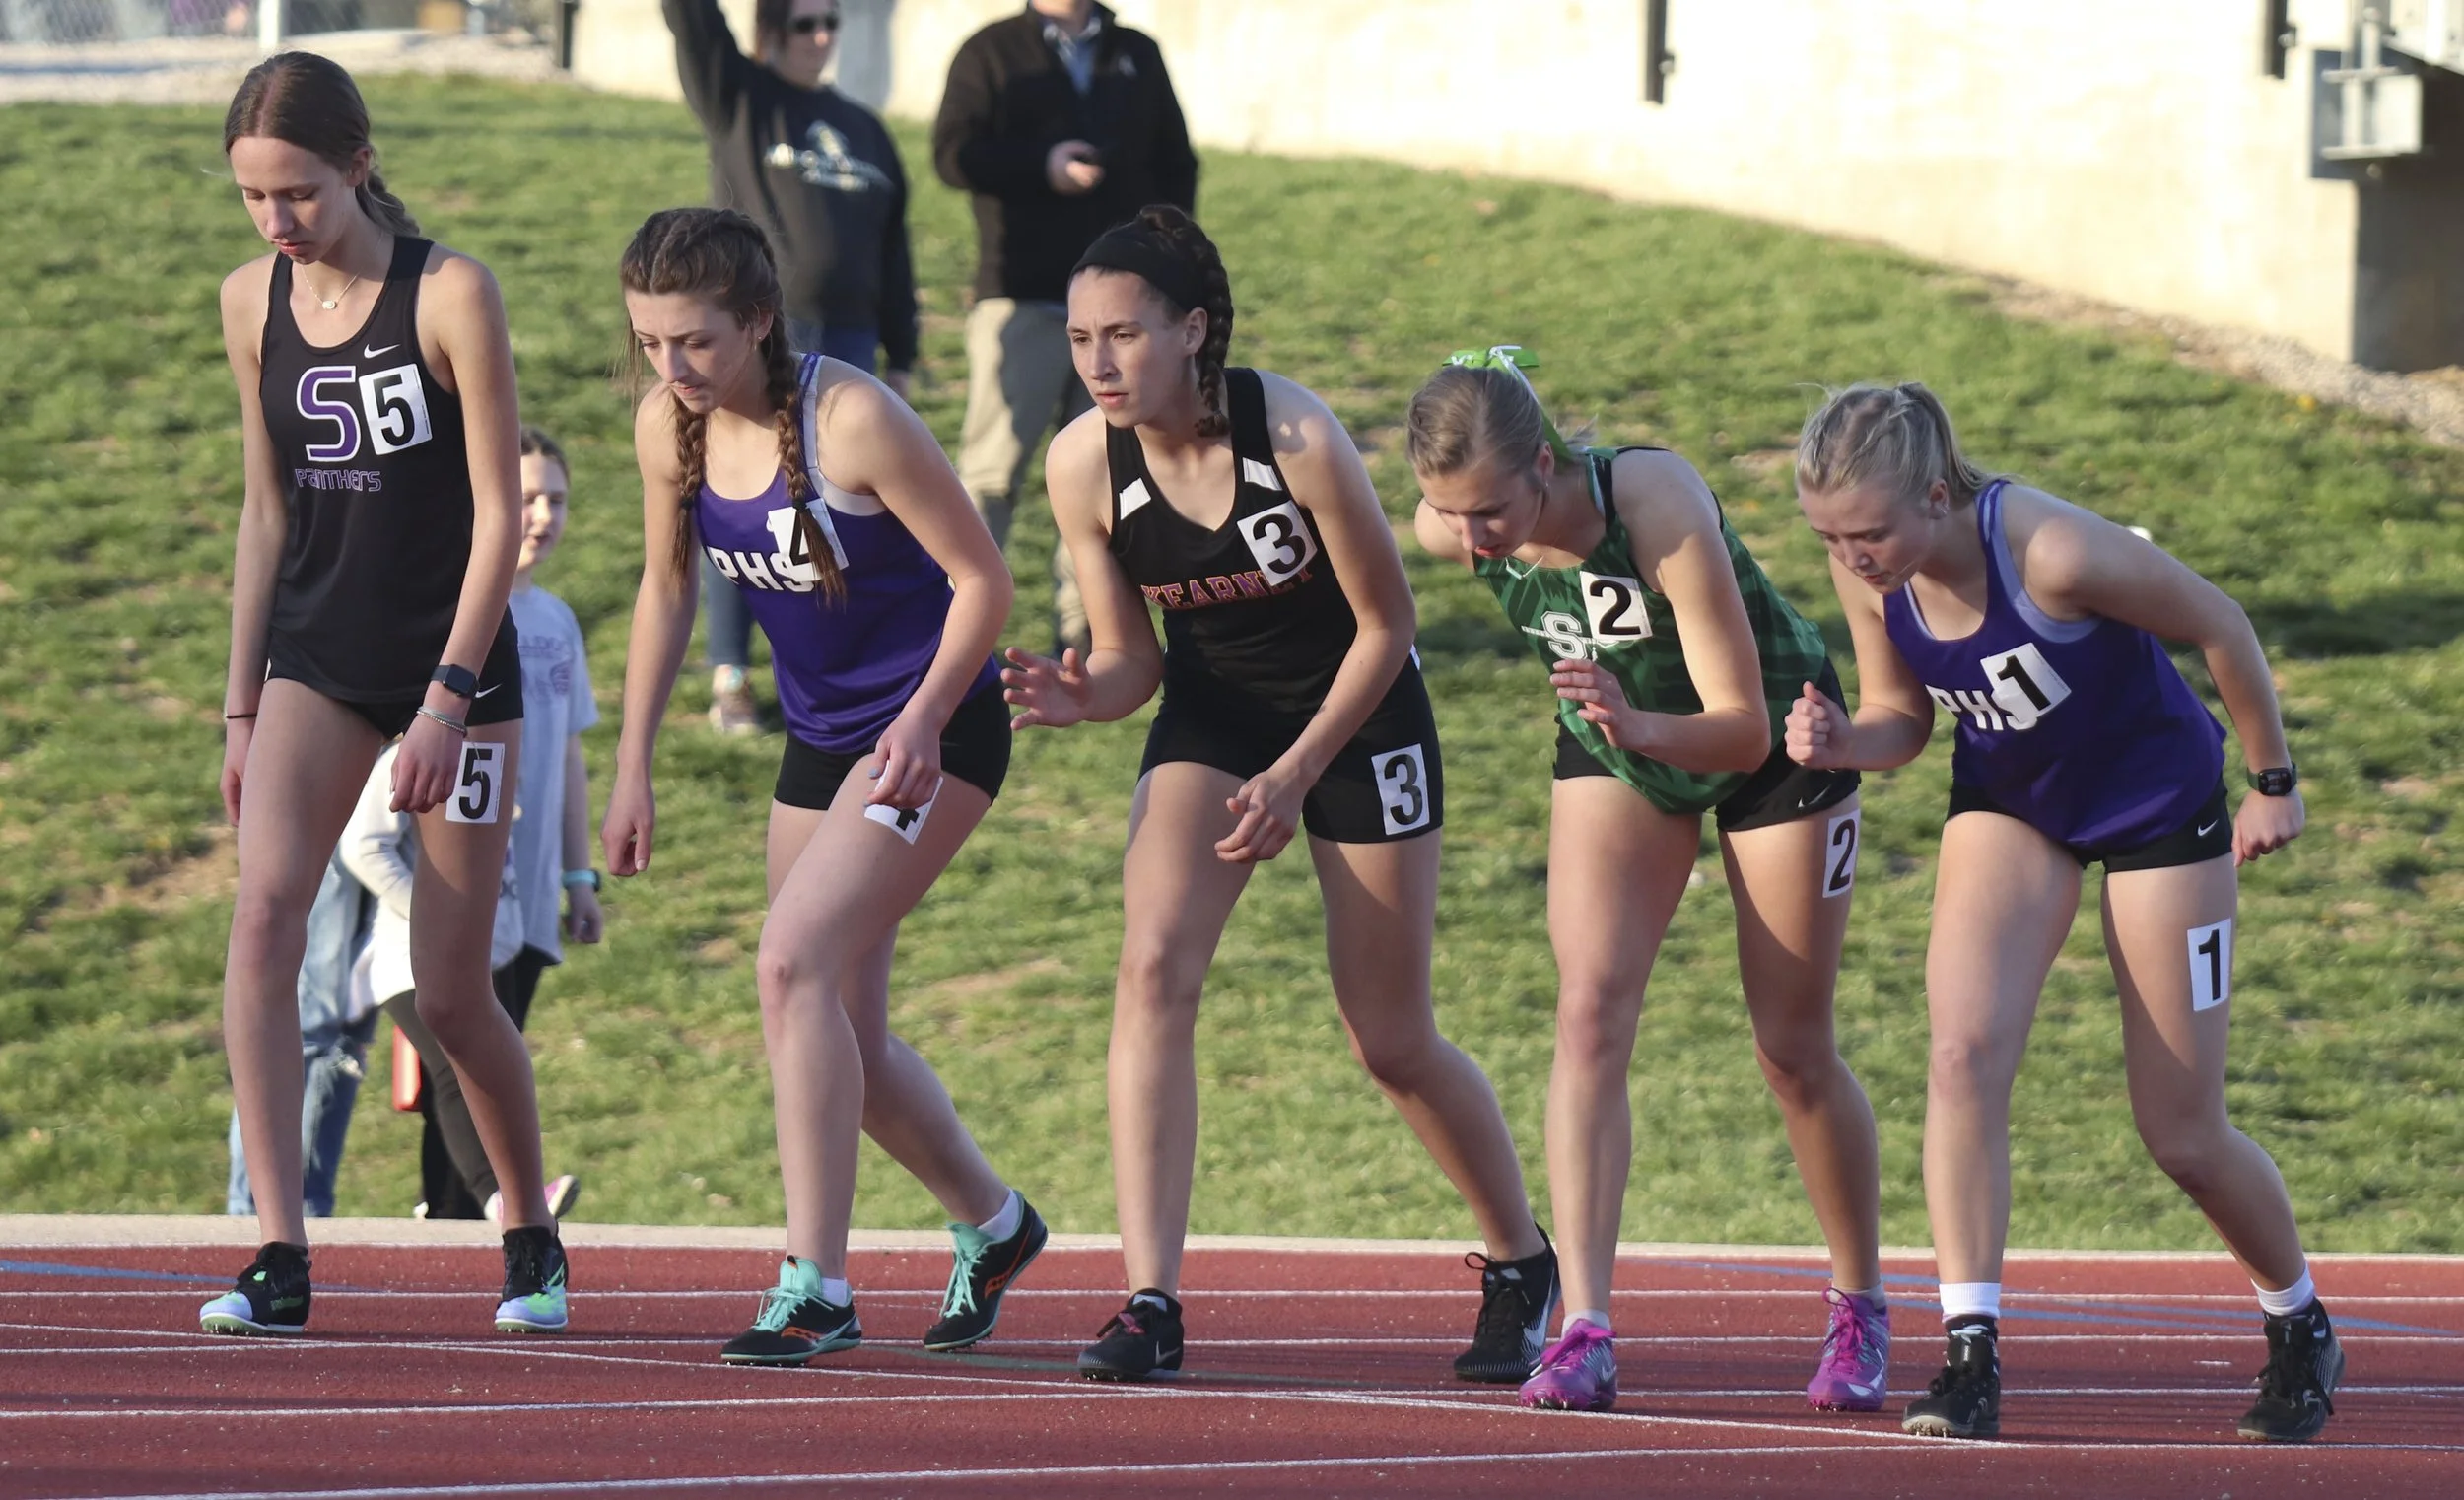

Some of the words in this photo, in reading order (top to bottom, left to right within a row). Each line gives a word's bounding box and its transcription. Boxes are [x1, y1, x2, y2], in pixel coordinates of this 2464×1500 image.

[297, 366, 361, 462] S
[373, 374, 415, 446] 5
[1253, 513, 1306, 574] 3
[1540, 611, 1588, 660] S
[1590, 580, 1641, 635] 2
[1997, 654, 2051, 711] 1
[458, 748, 492, 819] 5
[1384, 754, 1422, 825] 3
[1829, 819, 1855, 891] 2
[2198, 929, 2221, 1001] 1
